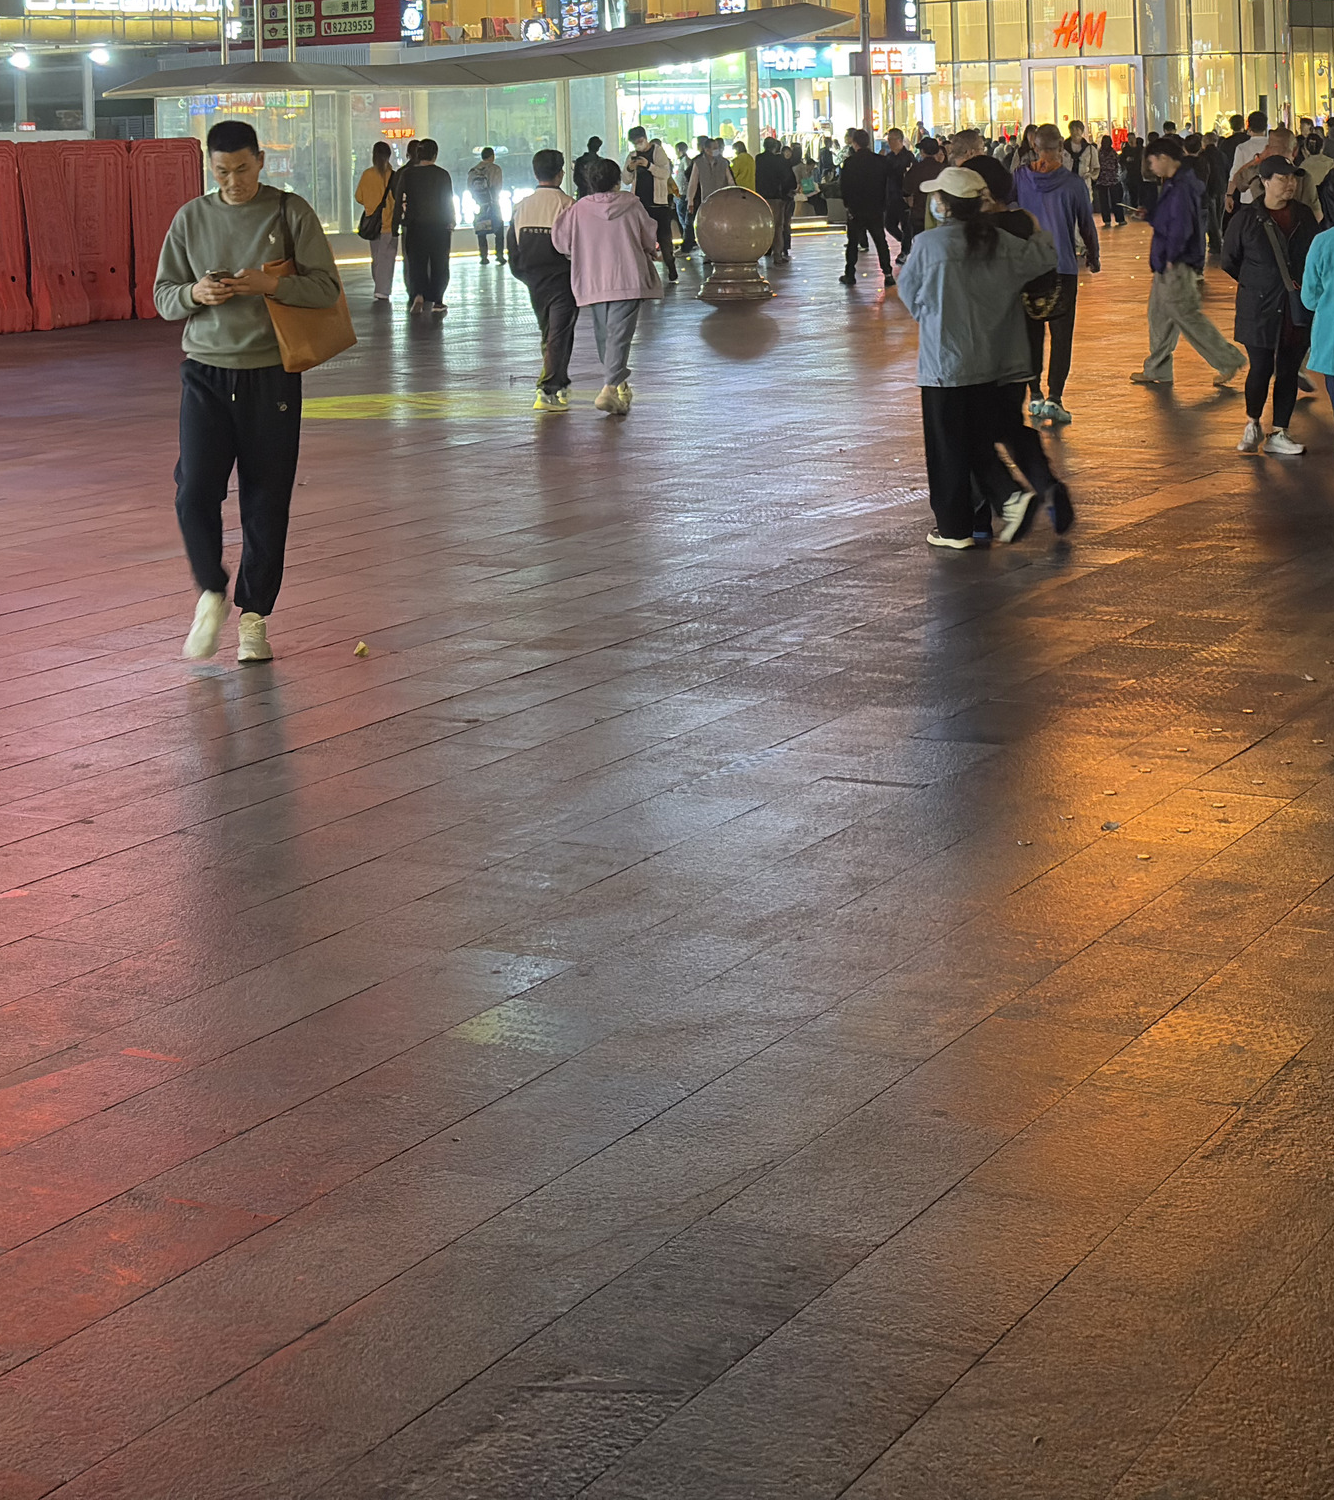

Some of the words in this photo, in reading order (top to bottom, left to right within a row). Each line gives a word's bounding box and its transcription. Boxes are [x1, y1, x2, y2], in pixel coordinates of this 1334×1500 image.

[341, 0, 369, 13] 潮州菜
[332, 18, 373, 33] 82239555
[1053, 11, 1107, 49] H&M
